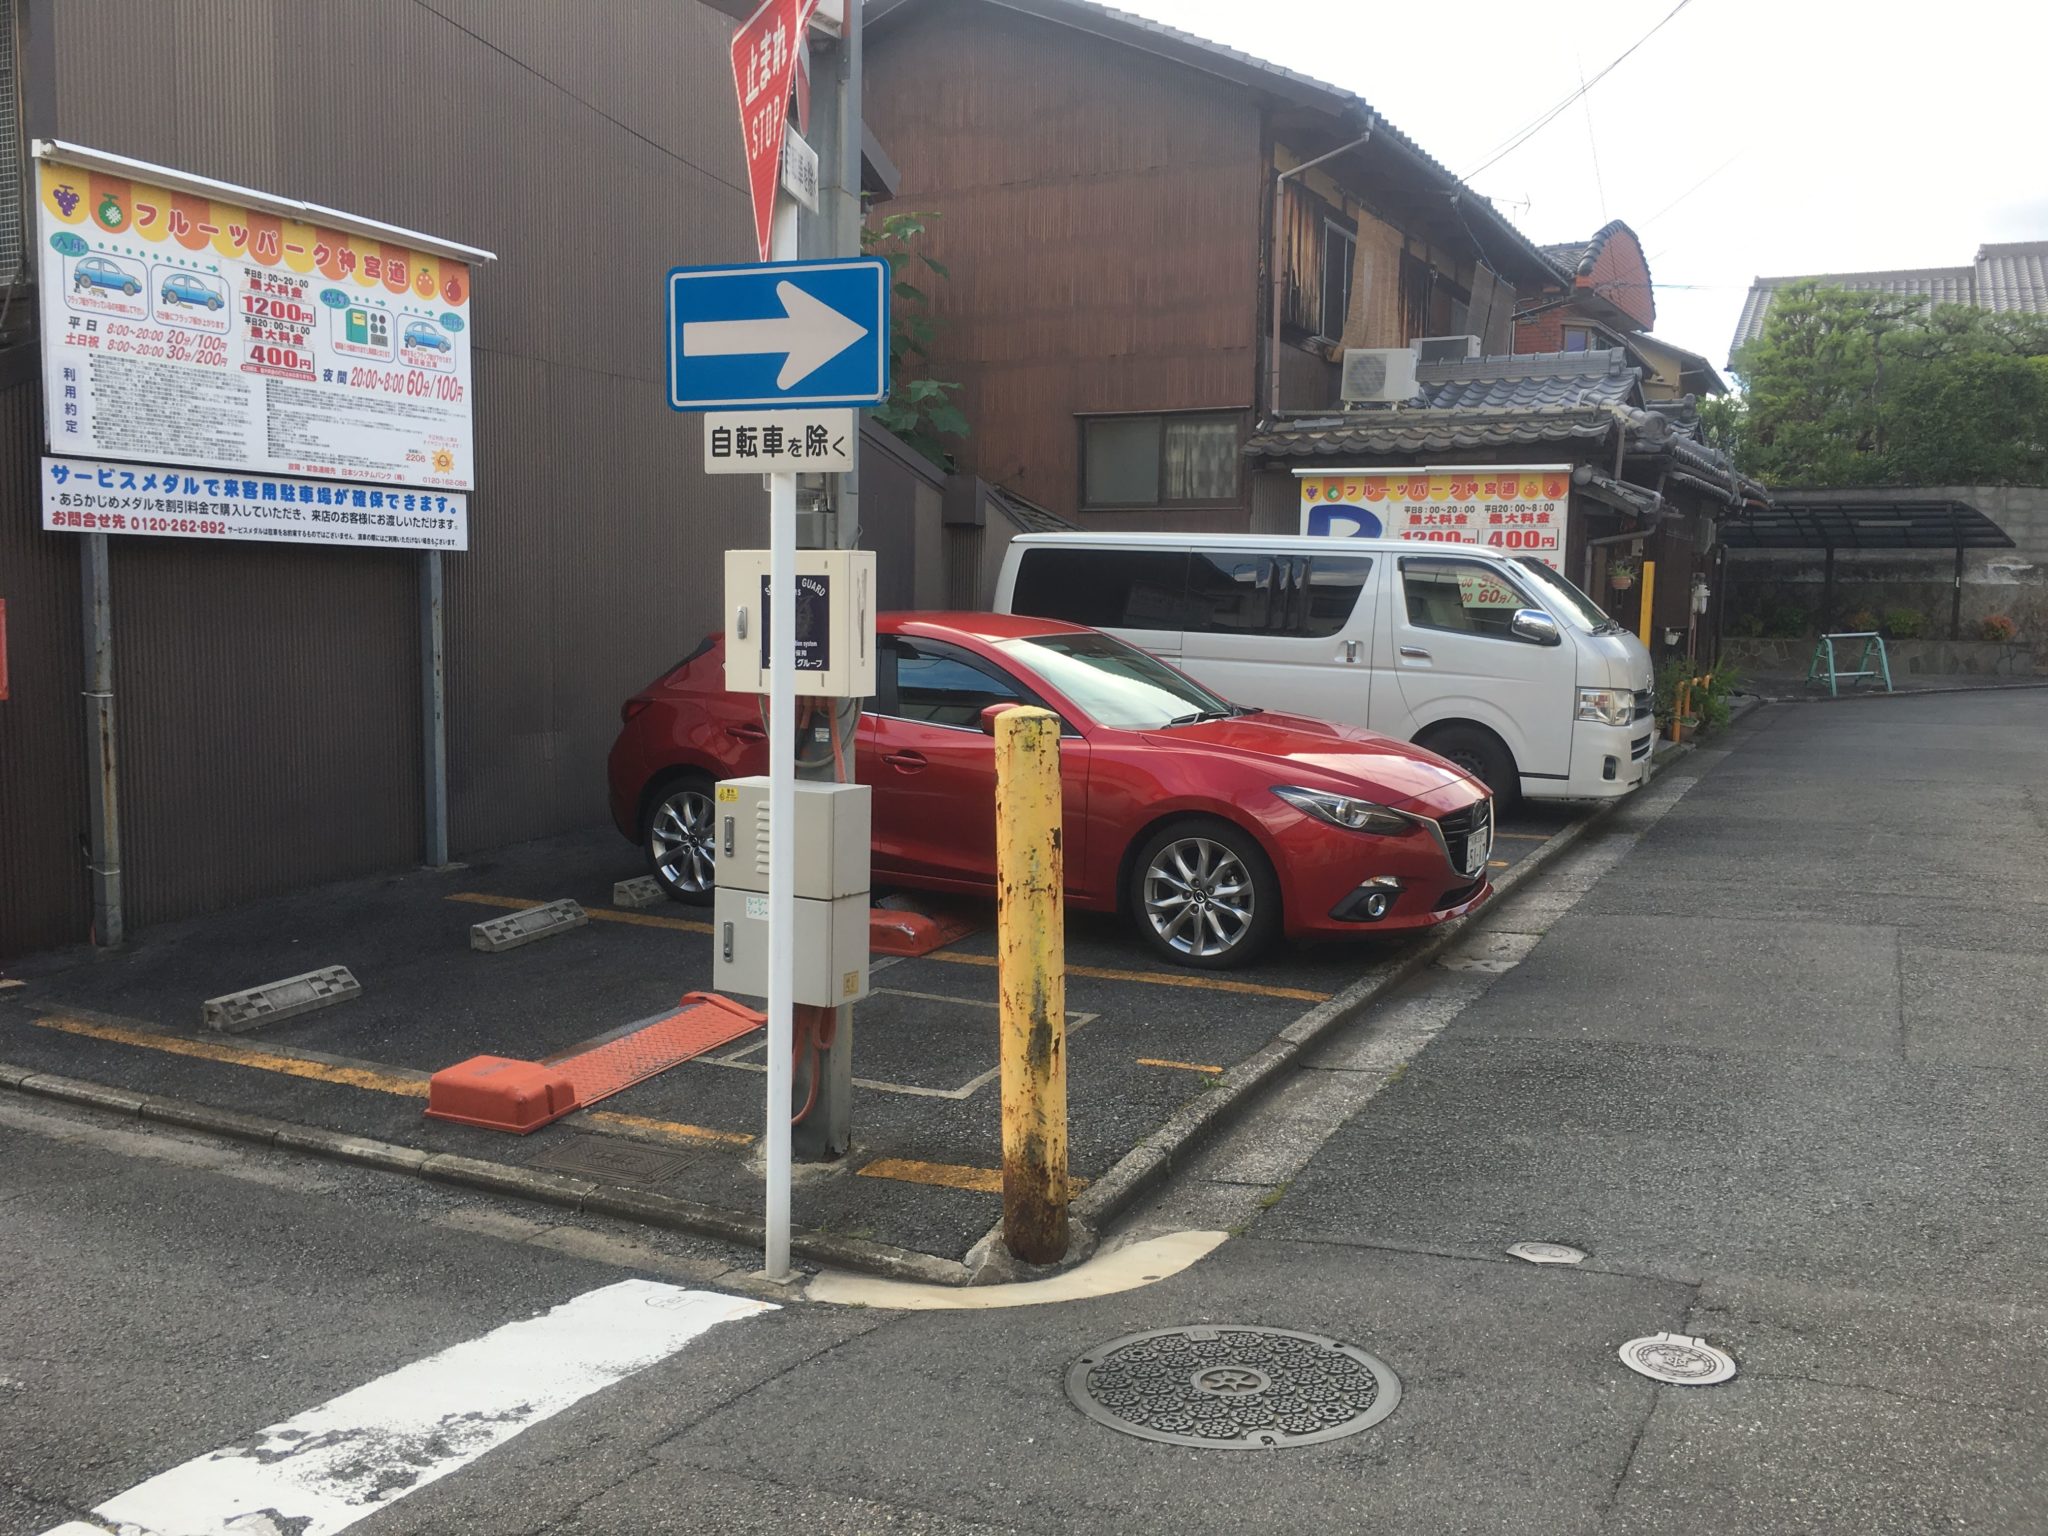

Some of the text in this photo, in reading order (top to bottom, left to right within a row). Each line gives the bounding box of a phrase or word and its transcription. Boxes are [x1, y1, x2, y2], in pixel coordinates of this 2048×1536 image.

[745, 15, 788, 106] 止まれ
[752, 95, 781, 161] STOP
[135, 202, 408, 286] フルーツパーク神宮道
[250, 278, 303, 299] 最大料金
[241, 295, 313, 323] 1200円
[67, 315, 98, 332] 平日
[166, 329, 228, 352] 20分/100円
[250, 326, 304, 346] 最大料金
[65, 332, 100, 349] 土日祝
[166, 345, 228, 367] 30分/200円
[250, 345, 312, 370] 400円
[322, 368, 348, 385] 夜間
[406, 369, 464, 403] 60分/100円
[63, 367, 79, 434] 利用約定
[711, 424, 847, 458] 自転車を除く
[405, 453, 426, 463] 2206
[50, 464, 458, 515] サービスメダルで来客用駐車場が確保できます。
[1346, 482, 1516, 496] フルーツパーク神宮道
[52, 510, 226, 535] お問合せ先 0120-262-892
[1409, 513, 1468, 525] 最大料金
[1489, 512, 1550, 524] 最大料金
[1488, 530, 1555, 548] 400円
[801, 578, 826, 597] GUARD
[797, 658, 823, 668] グループ
